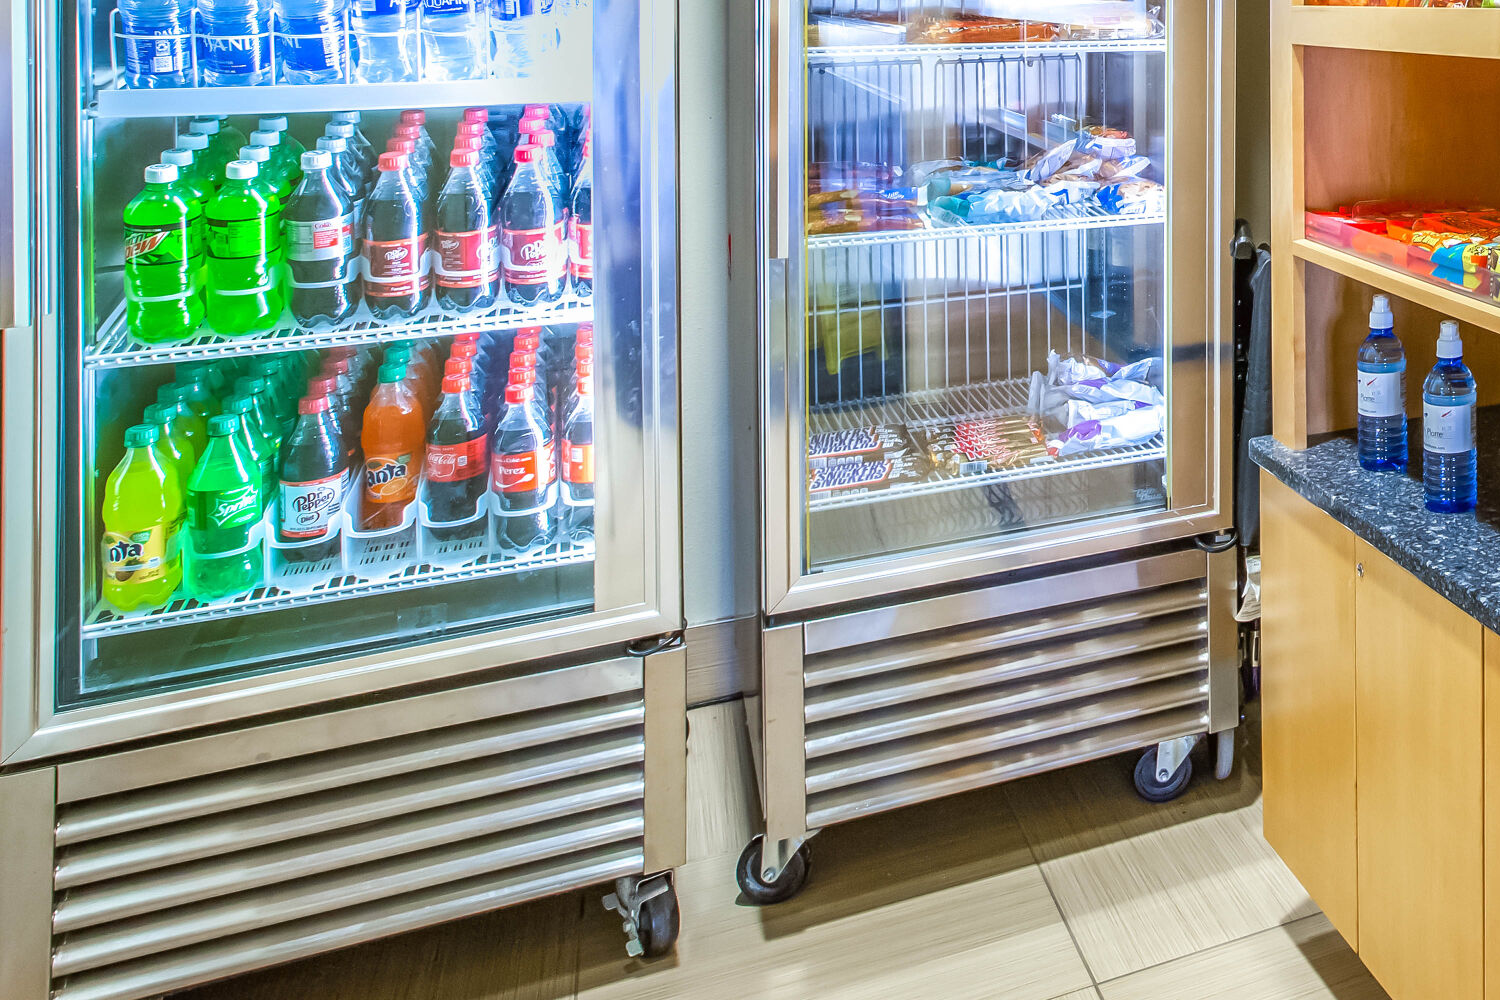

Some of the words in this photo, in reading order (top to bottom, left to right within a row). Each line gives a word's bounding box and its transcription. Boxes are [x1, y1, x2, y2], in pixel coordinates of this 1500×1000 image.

[1427, 428, 1443, 437] Platte
[499, 466, 525, 475] Perez
[307, 491, 321, 503] Dr
[215, 494, 258, 516] Sprite
[294, 493, 333, 512] Pepper
[300, 515, 315, 524] Diet
